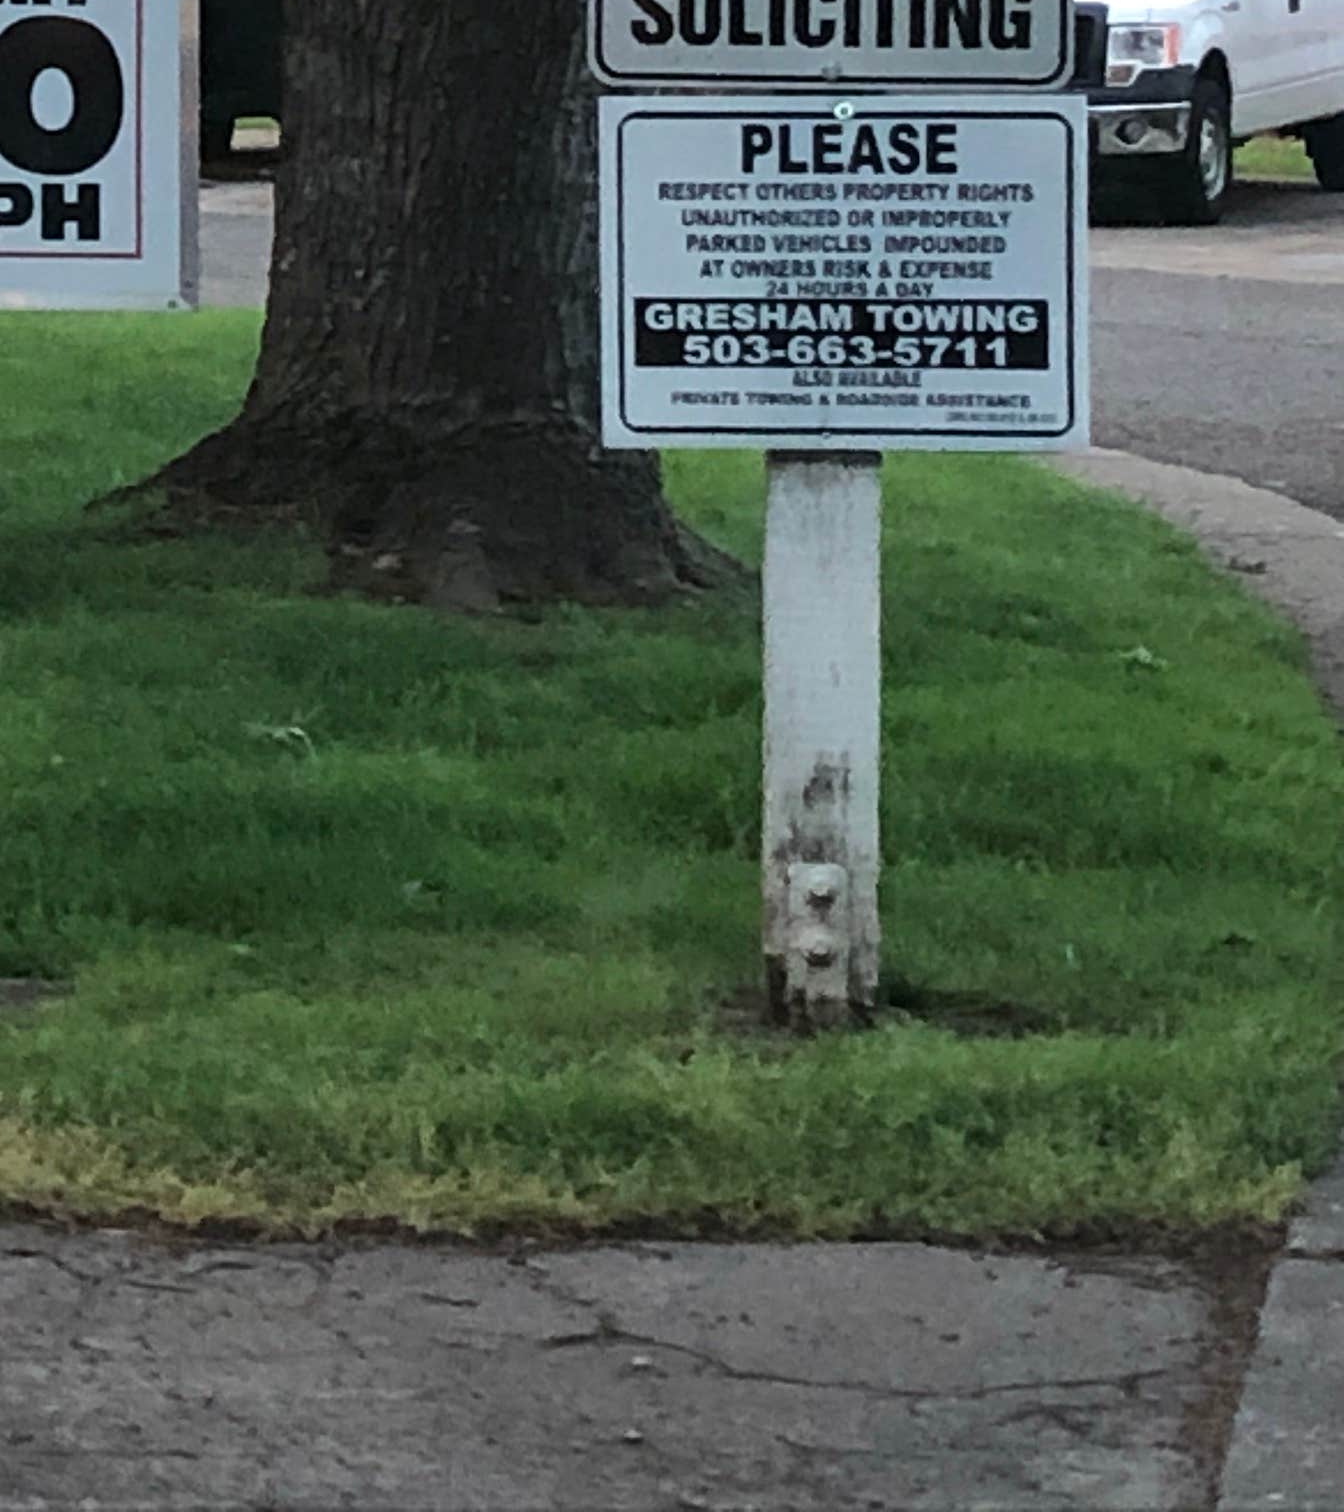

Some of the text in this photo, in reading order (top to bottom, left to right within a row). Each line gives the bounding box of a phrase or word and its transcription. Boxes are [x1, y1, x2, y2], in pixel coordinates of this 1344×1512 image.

[741, 123, 959, 174] PLEASE
[659, 183, 1034, 202] RESPECT OTHERS PROPERTY RIGHTS
[681, 209, 1011, 228] UNAUTHORIZED OR IMPROPERLY
[686, 235, 1007, 253] PARKED VEHICLES IMPOUNDED
[700, 260, 993, 279] AT OWNERS RISK & EXPENSE
[766, 281, 934, 298] 24 HOURS A DAY
[644, 303, 1040, 333] GRESHAM TOWING
[683, 335, 1008, 366] 503-663-5711
